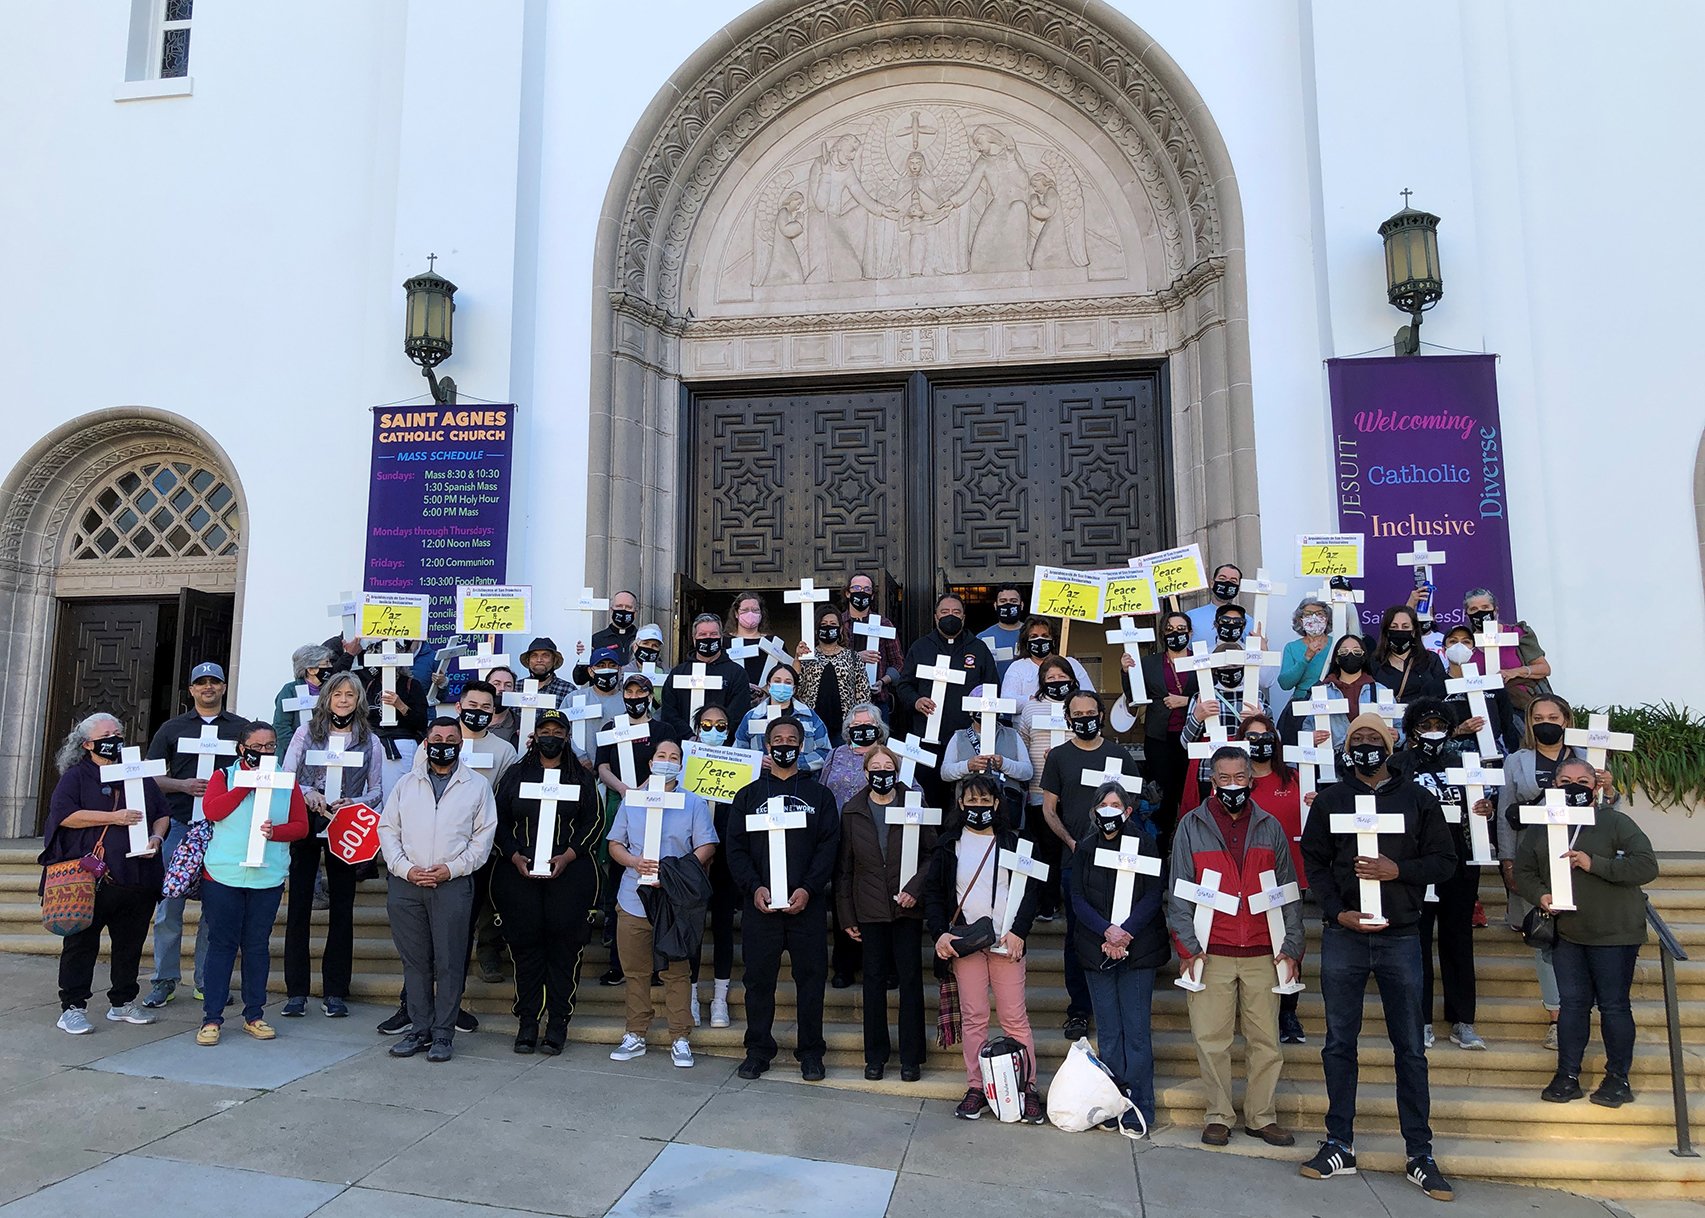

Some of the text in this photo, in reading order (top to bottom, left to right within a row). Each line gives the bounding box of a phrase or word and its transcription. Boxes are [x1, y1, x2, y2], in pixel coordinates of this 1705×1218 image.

[379, 410, 507, 429] SAINT AGNES
[1354, 409, 1478, 440] Welcoming
[378, 429, 506, 444] CATHOLIC CHURCH
[396, 450, 484, 462] MASS SCHEDULE
[376, 470, 415, 482] Sundays:
[424, 469, 500, 480] Mass 8:30 & 10:30
[1338, 435, 1367, 519] JESUIT
[1368, 464, 1471, 487] Catholic
[1479, 425, 1504, 520] Diverse
[424, 481, 498, 494] 1:30 Spanish Mass
[423, 493, 500, 506] 5:00 PM Holy Hour
[422, 506, 479, 518] 6:00 PM Mass
[372, 525, 495, 538] Mondays through Thursdays:
[1371, 513, 1476, 538] Inclusive
[421, 538, 491, 549] 12:00 Noon Mass
[1318, 546, 1339, 559] Paz
[370, 557, 495, 569] Fridays: 12:00 Communion
[1306, 561, 1347, 575] Justicia
[1153, 565, 1183, 577] Peace
[369, 575, 497, 588] Thursdays: 1:30-3:00 Food Pantry
[1106, 582, 1137, 595] Peace
[1058, 583, 1080, 599] Paz
[438, 596, 452, 606] PM
[476, 599, 511, 614] Peace
[1043, 599, 1086, 617] Justicia
[1104, 599, 1142, 613] Justice
[379, 607, 402, 621] Paz
[428, 608, 457, 619] concilia
[367, 621, 410, 637] Justicia
[428, 621, 456, 631] nfessio
[470, 615, 513, 631] Justice
[472, 634, 485, 644] PM
[698, 760, 737, 779] Peace
[692, 777, 736, 799] Justice
[338, 808, 376, 859] STOP
